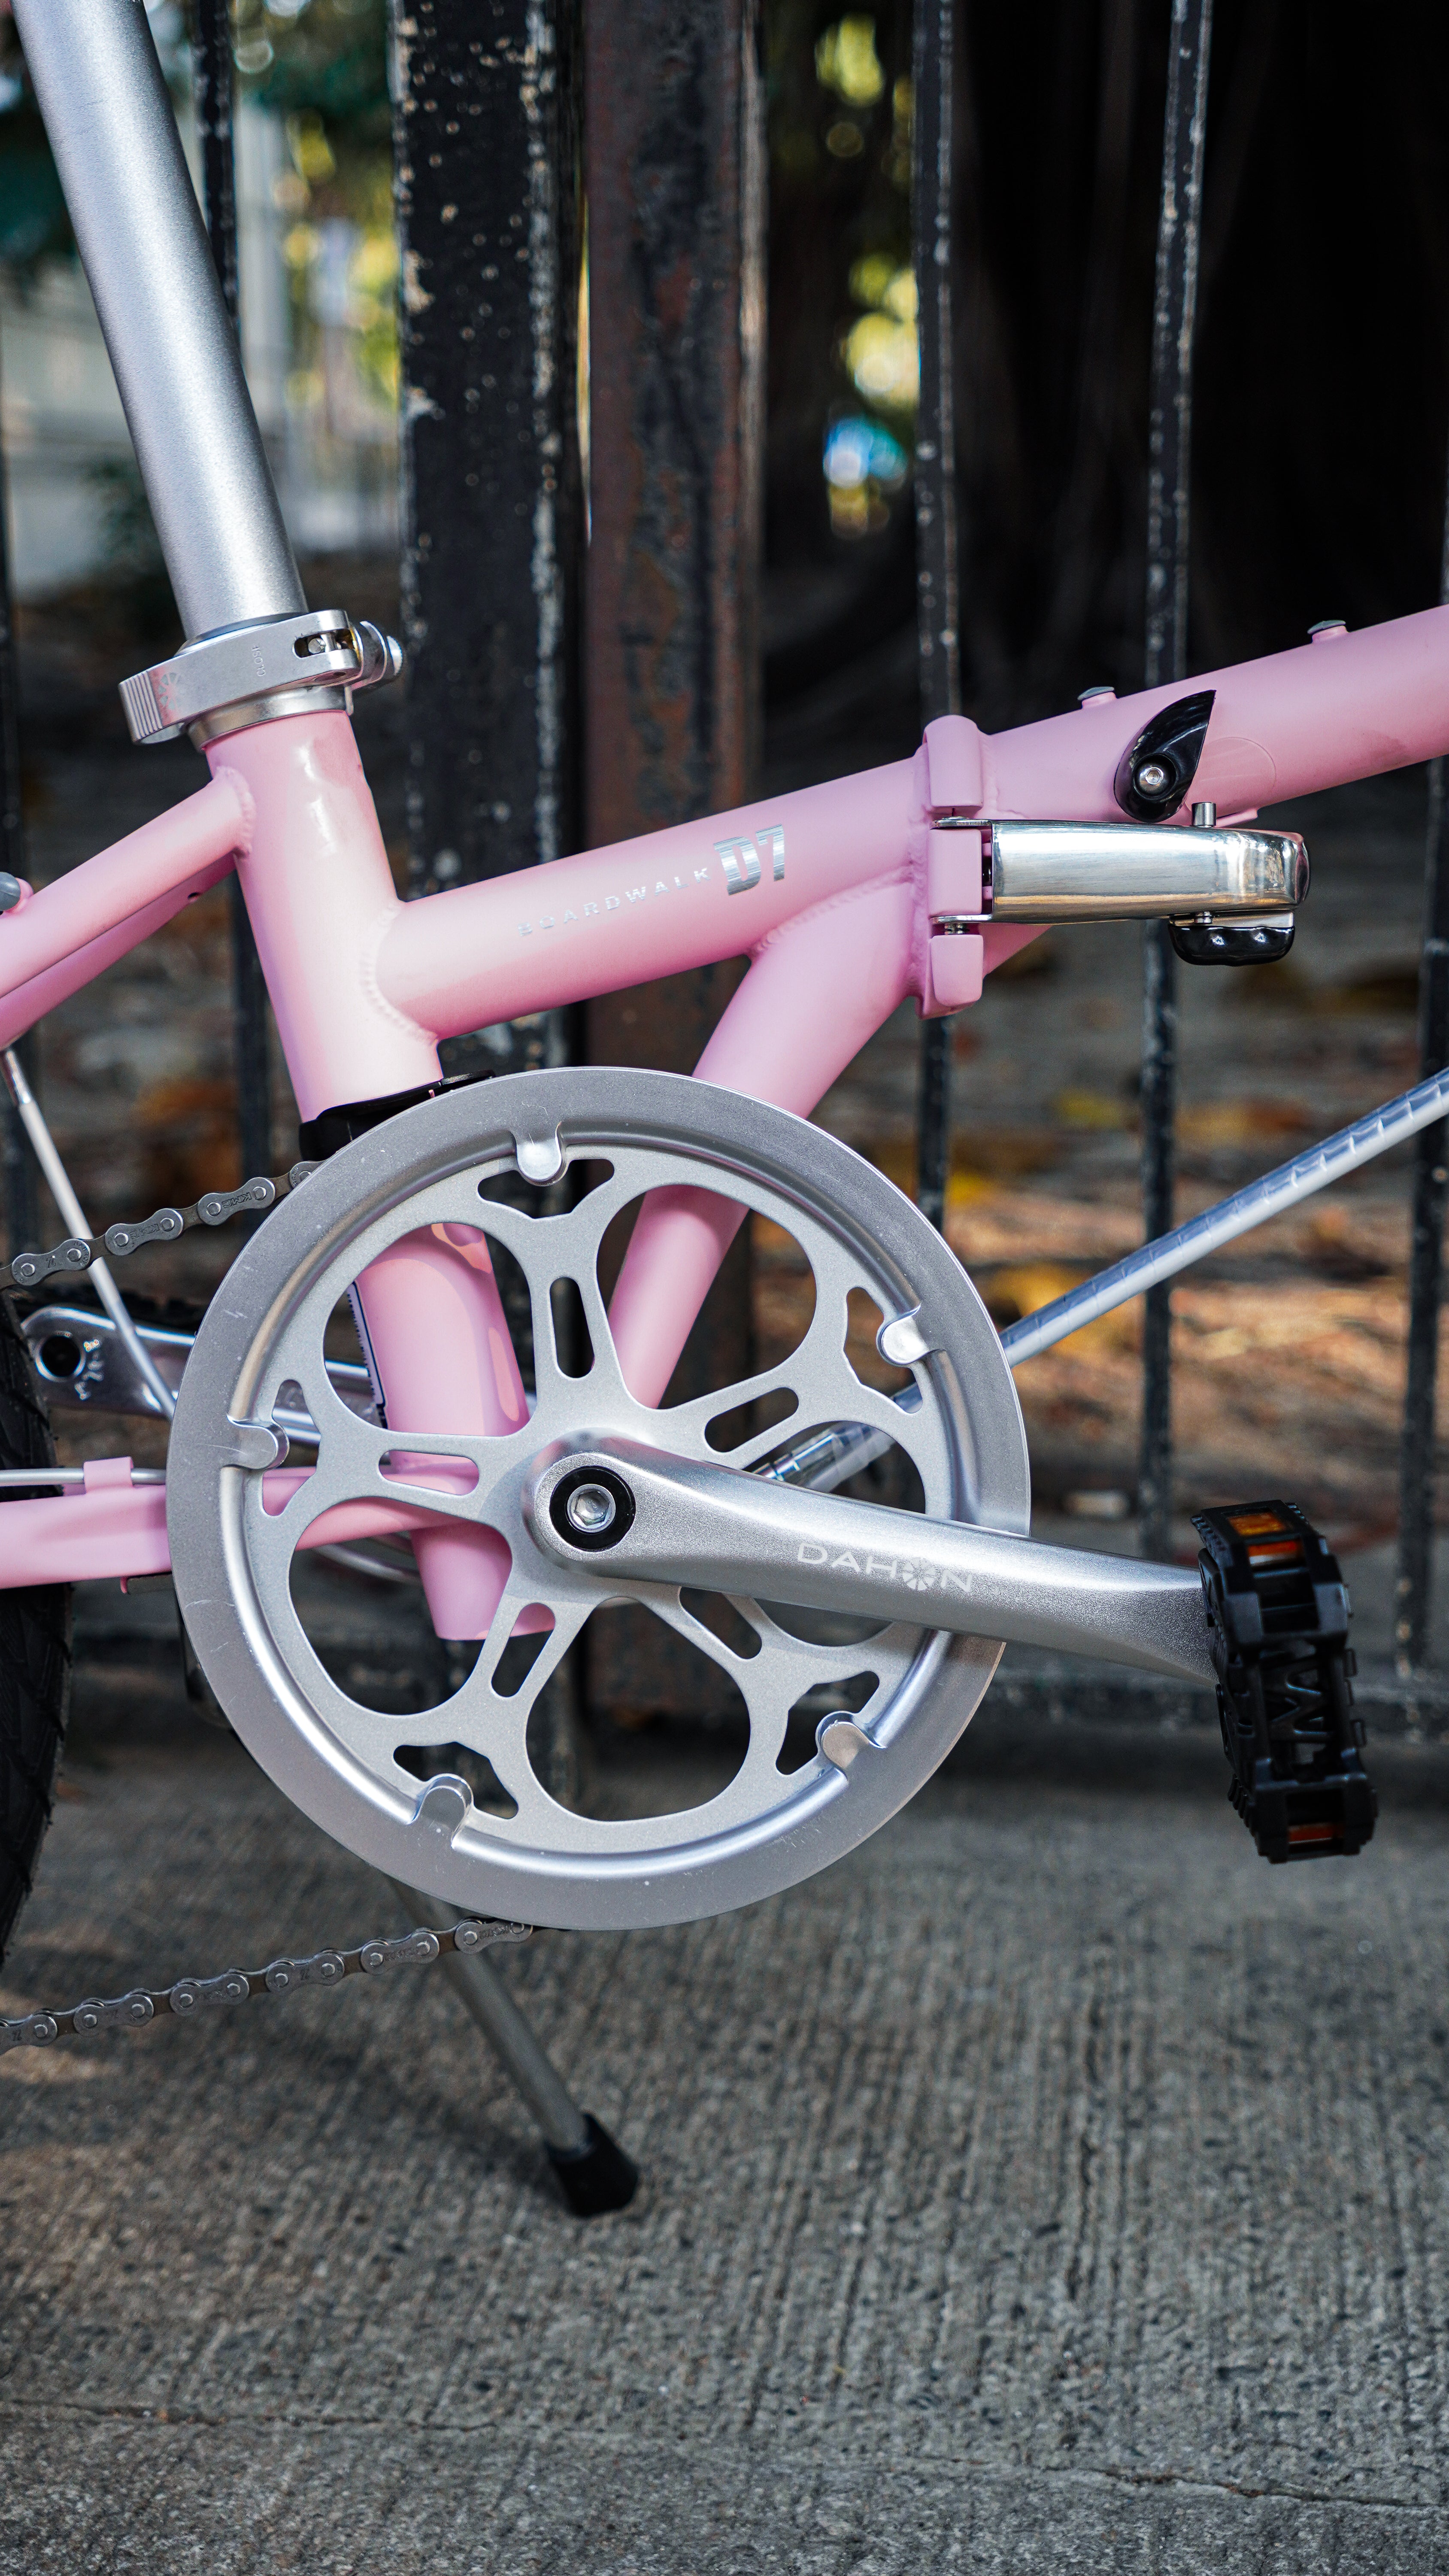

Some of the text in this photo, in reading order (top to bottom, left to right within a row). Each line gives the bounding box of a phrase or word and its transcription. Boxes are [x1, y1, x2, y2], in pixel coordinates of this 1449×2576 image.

[251, 644, 266, 677] CLOSE
[517, 823, 785, 936] BOARDWALK D7
[221, 1192, 252, 1209] KMC
[797, 1542, 973, 1592] DAHON
